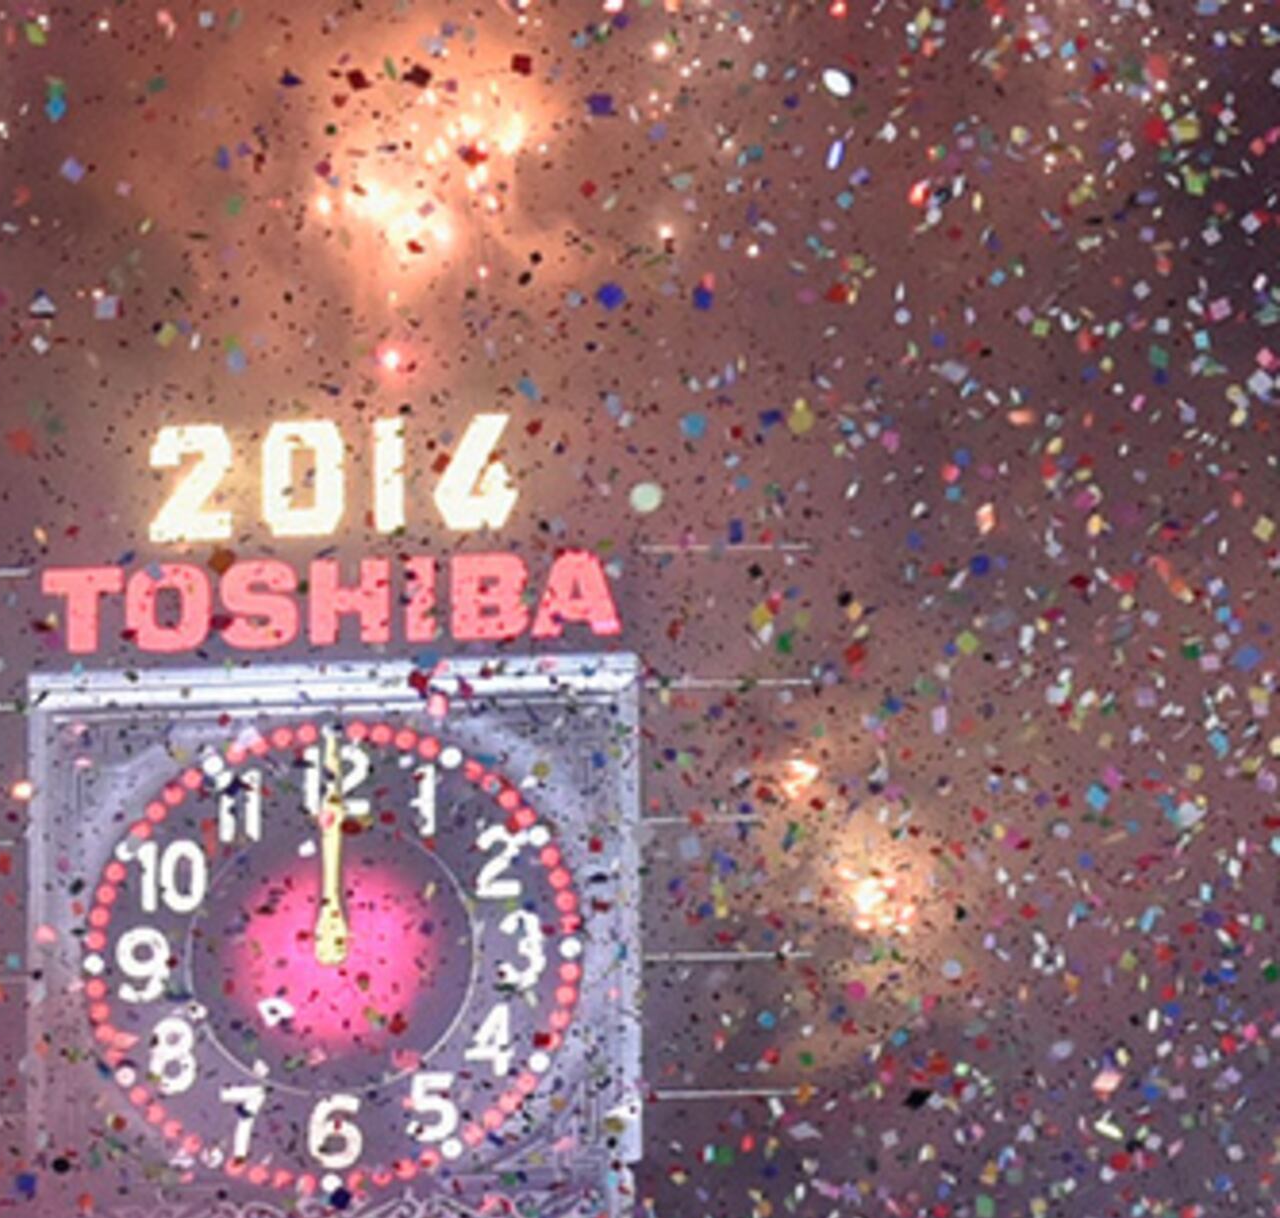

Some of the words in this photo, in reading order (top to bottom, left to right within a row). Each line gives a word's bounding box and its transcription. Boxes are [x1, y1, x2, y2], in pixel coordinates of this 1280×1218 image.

[41, 549, 622, 654] TOSHIBA
[216, 770, 262, 843] 11
[303, 746, 370, 816] 12
[410, 764, 435, 836] 1
[138, 839, 207, 913] 10
[476, 825, 528, 897] 2
[117, 928, 171, 1001] 9
[499, 909, 547, 990] 3
[150, 1017, 197, 1094] 8
[465, 1005, 513, 1076] 4
[221, 1086, 266, 1158] 7
[309, 1095, 363, 1167] 6
[409, 1072, 458, 1142] 5
